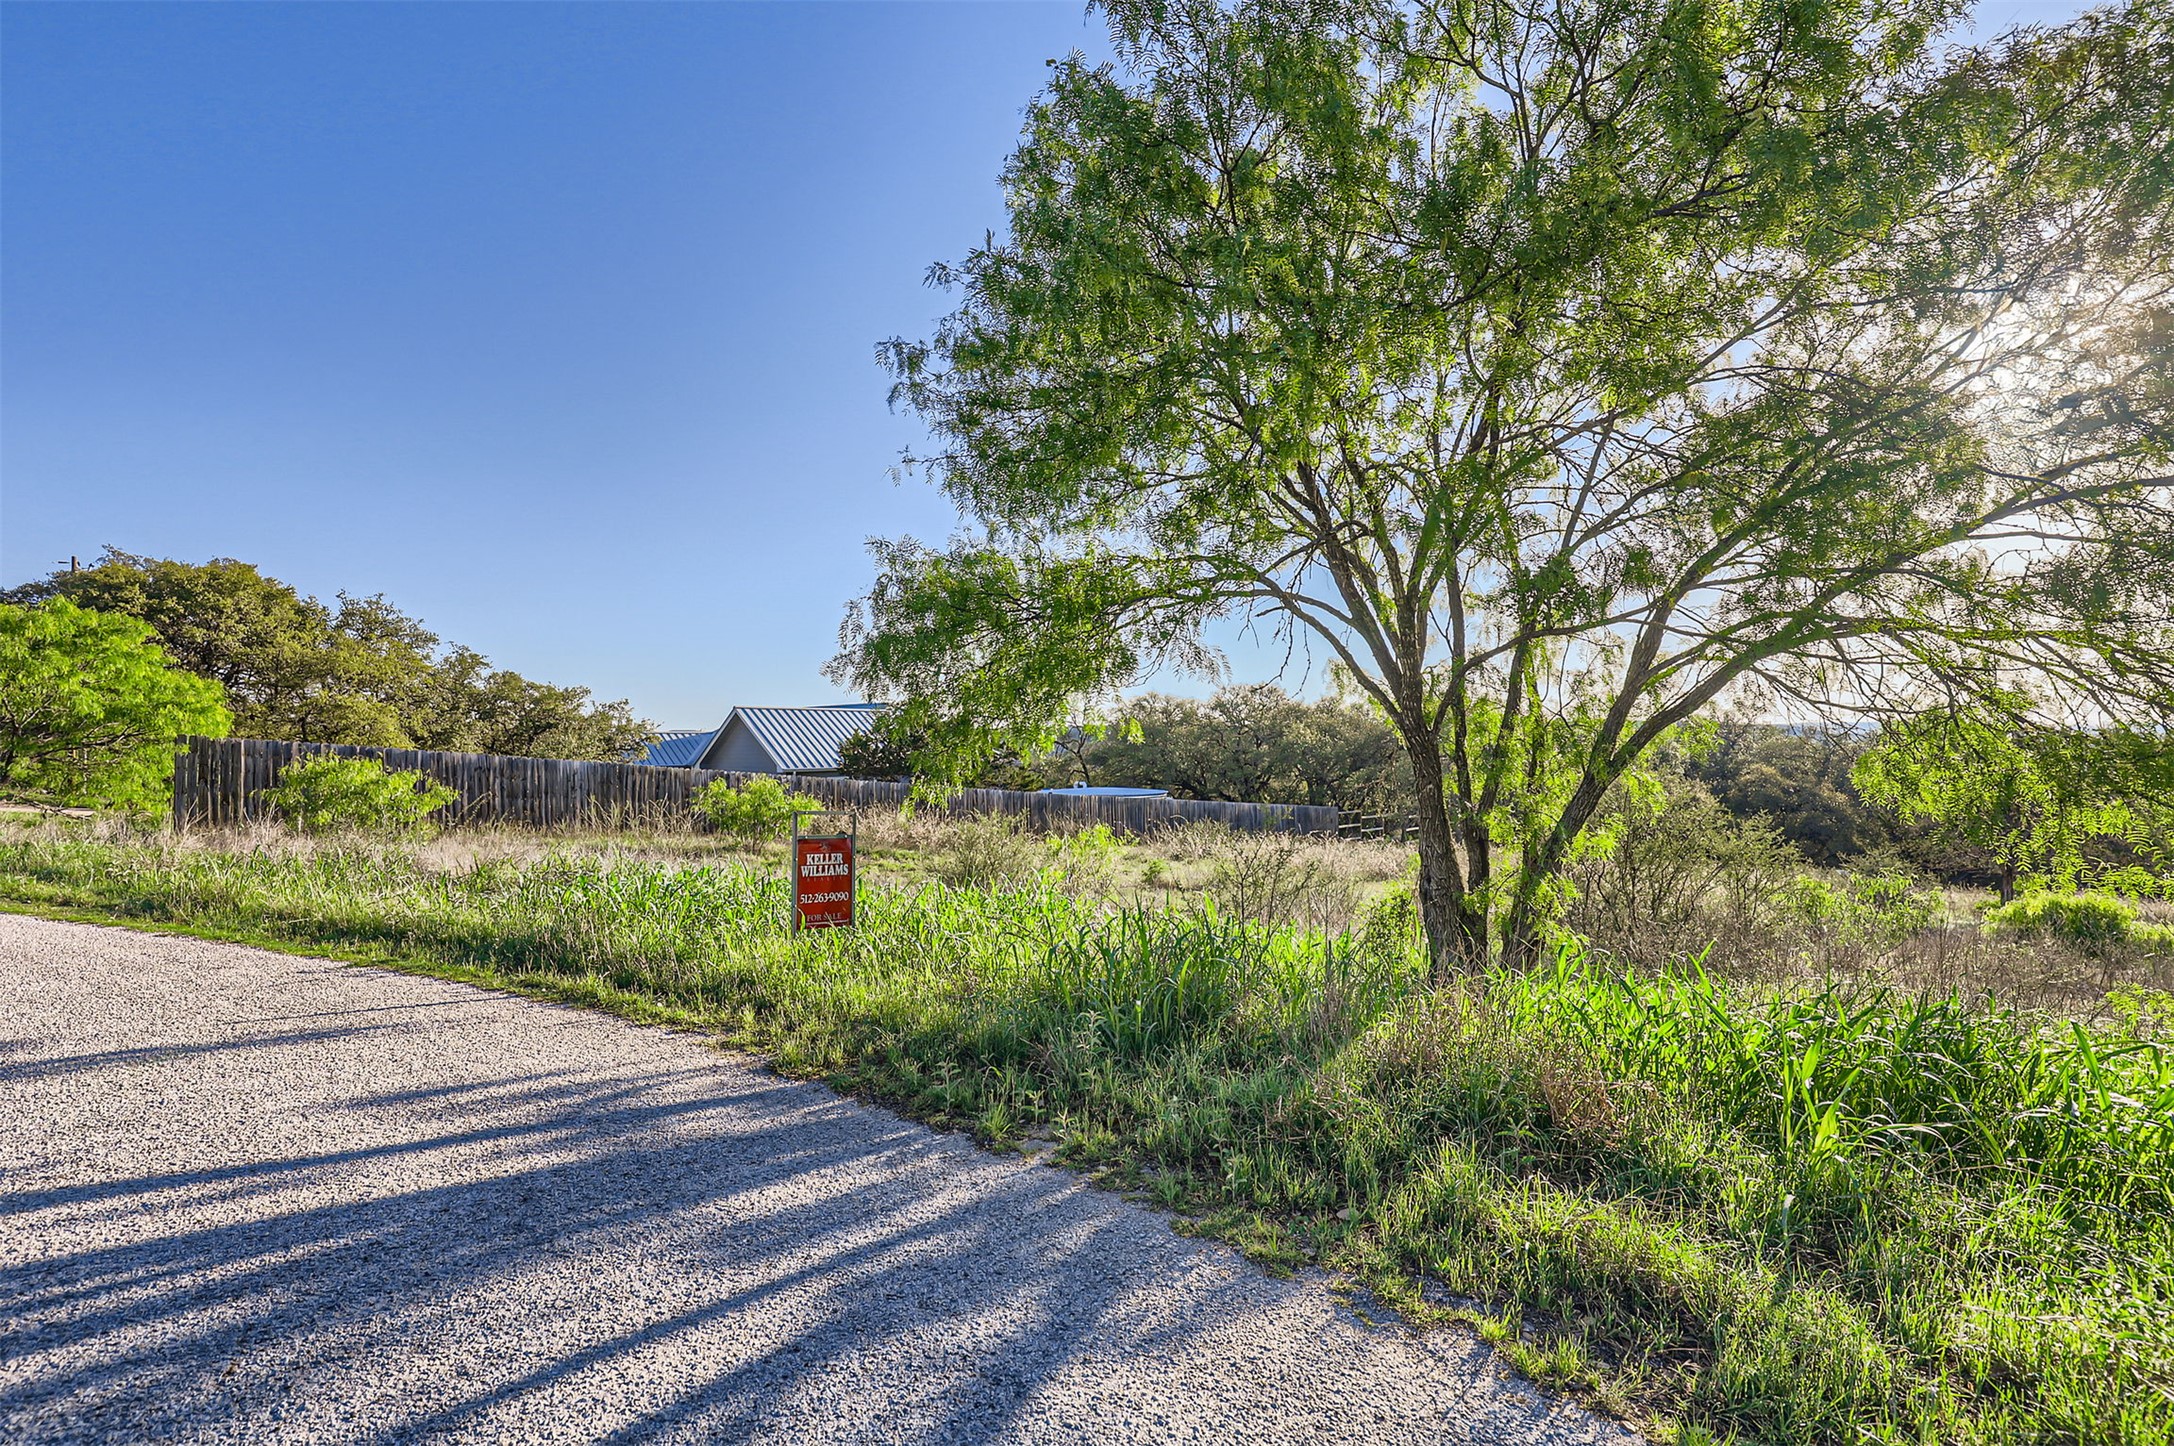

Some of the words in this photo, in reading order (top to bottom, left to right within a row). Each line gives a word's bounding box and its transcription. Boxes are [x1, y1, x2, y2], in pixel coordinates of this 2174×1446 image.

[806, 853, 843, 865] KELLER
[801, 864, 849, 877] WILLIAMS
[807, 914, 822, 922] FOR
